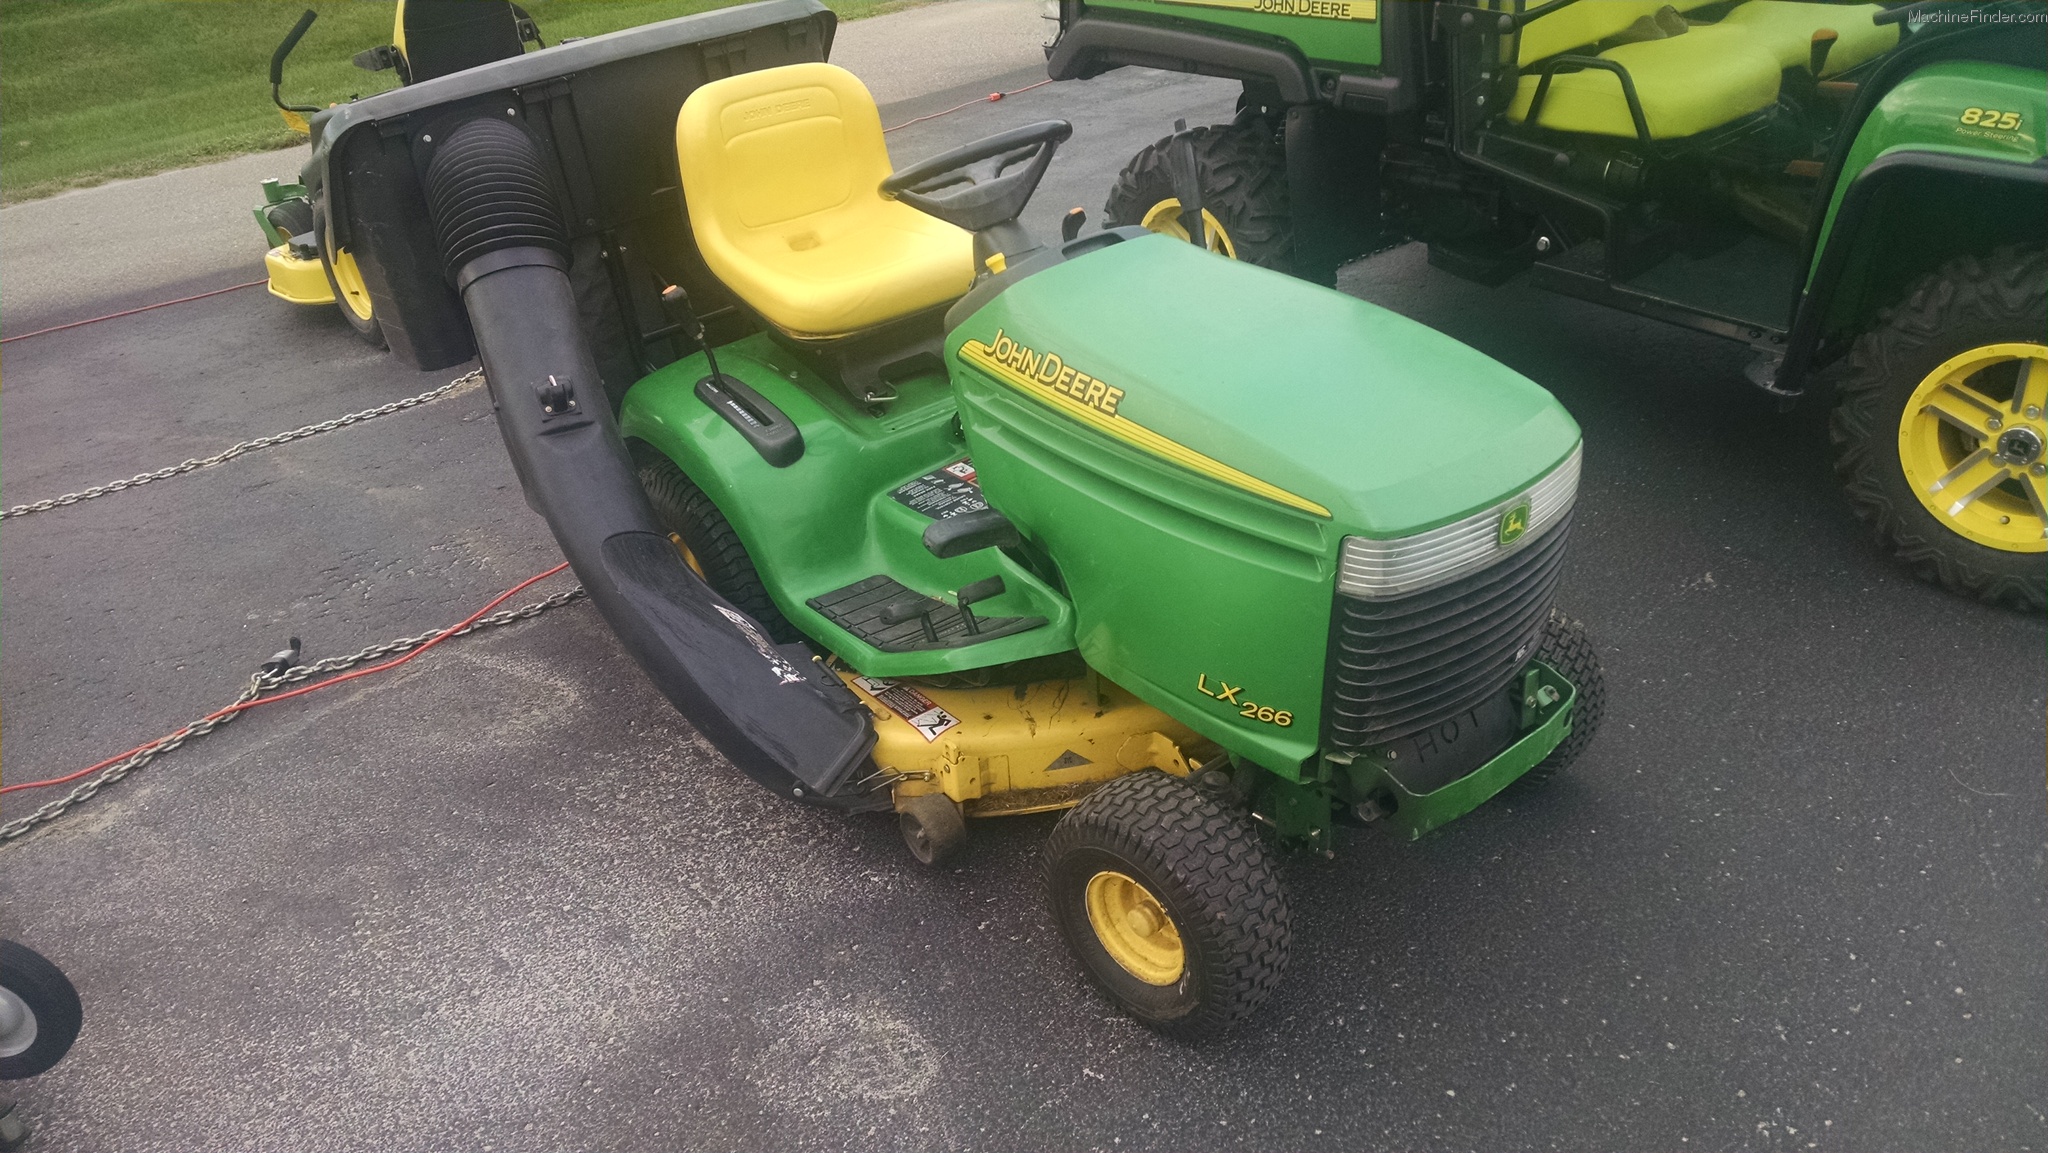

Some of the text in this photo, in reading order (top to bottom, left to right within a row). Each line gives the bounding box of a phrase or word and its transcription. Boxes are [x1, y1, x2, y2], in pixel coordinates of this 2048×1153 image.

[1253, 0, 1352, 18] JOHN DEERE
[775, 98, 811, 116] DEERE
[1955, 127, 2020, 143] Power Steering
[983, 327, 1127, 418] JOHN DEERE
[1239, 701, 1294, 727] 266
